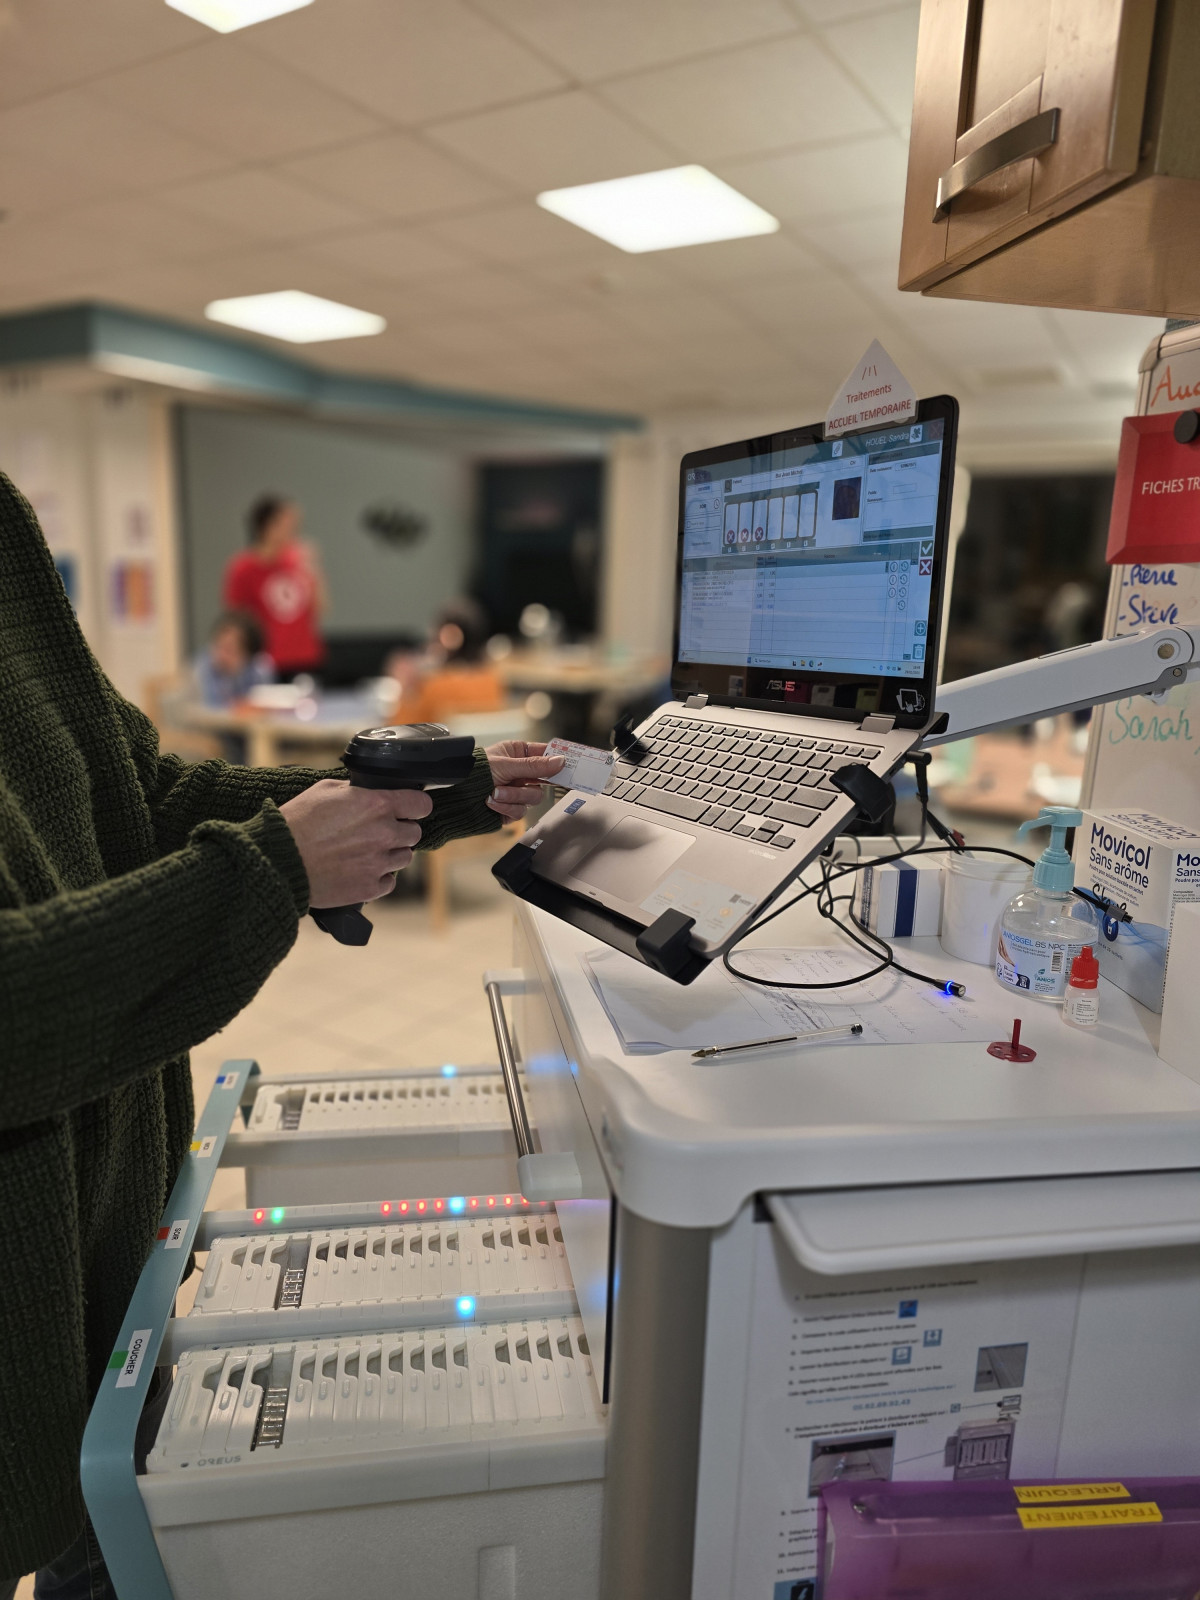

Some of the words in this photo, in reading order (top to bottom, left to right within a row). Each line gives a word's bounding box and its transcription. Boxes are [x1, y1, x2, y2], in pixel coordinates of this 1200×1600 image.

[846, 384, 892, 404] Traitements
[829, 416, 859, 431] ACCUEIL
[860, 399, 912, 422] TEMPORAIRE
[1141, 479, 1185, 496] FICHES
[766, 680, 795, 692] ASUS
[1090, 822, 1151, 870] Movicol
[1089, 847, 1112, 870] Sans
[1114, 862, 1149, 889] arôme
[1003, 930, 1034, 947] ANIOSGEL
[1047, 943, 1066, 951] NPC
[124, 1338, 144, 1376] COUCHER
[1017, 1485, 1122, 1499] ARLEQUIN
[1024, 1507, 1161, 1522] TRAITEMENT
